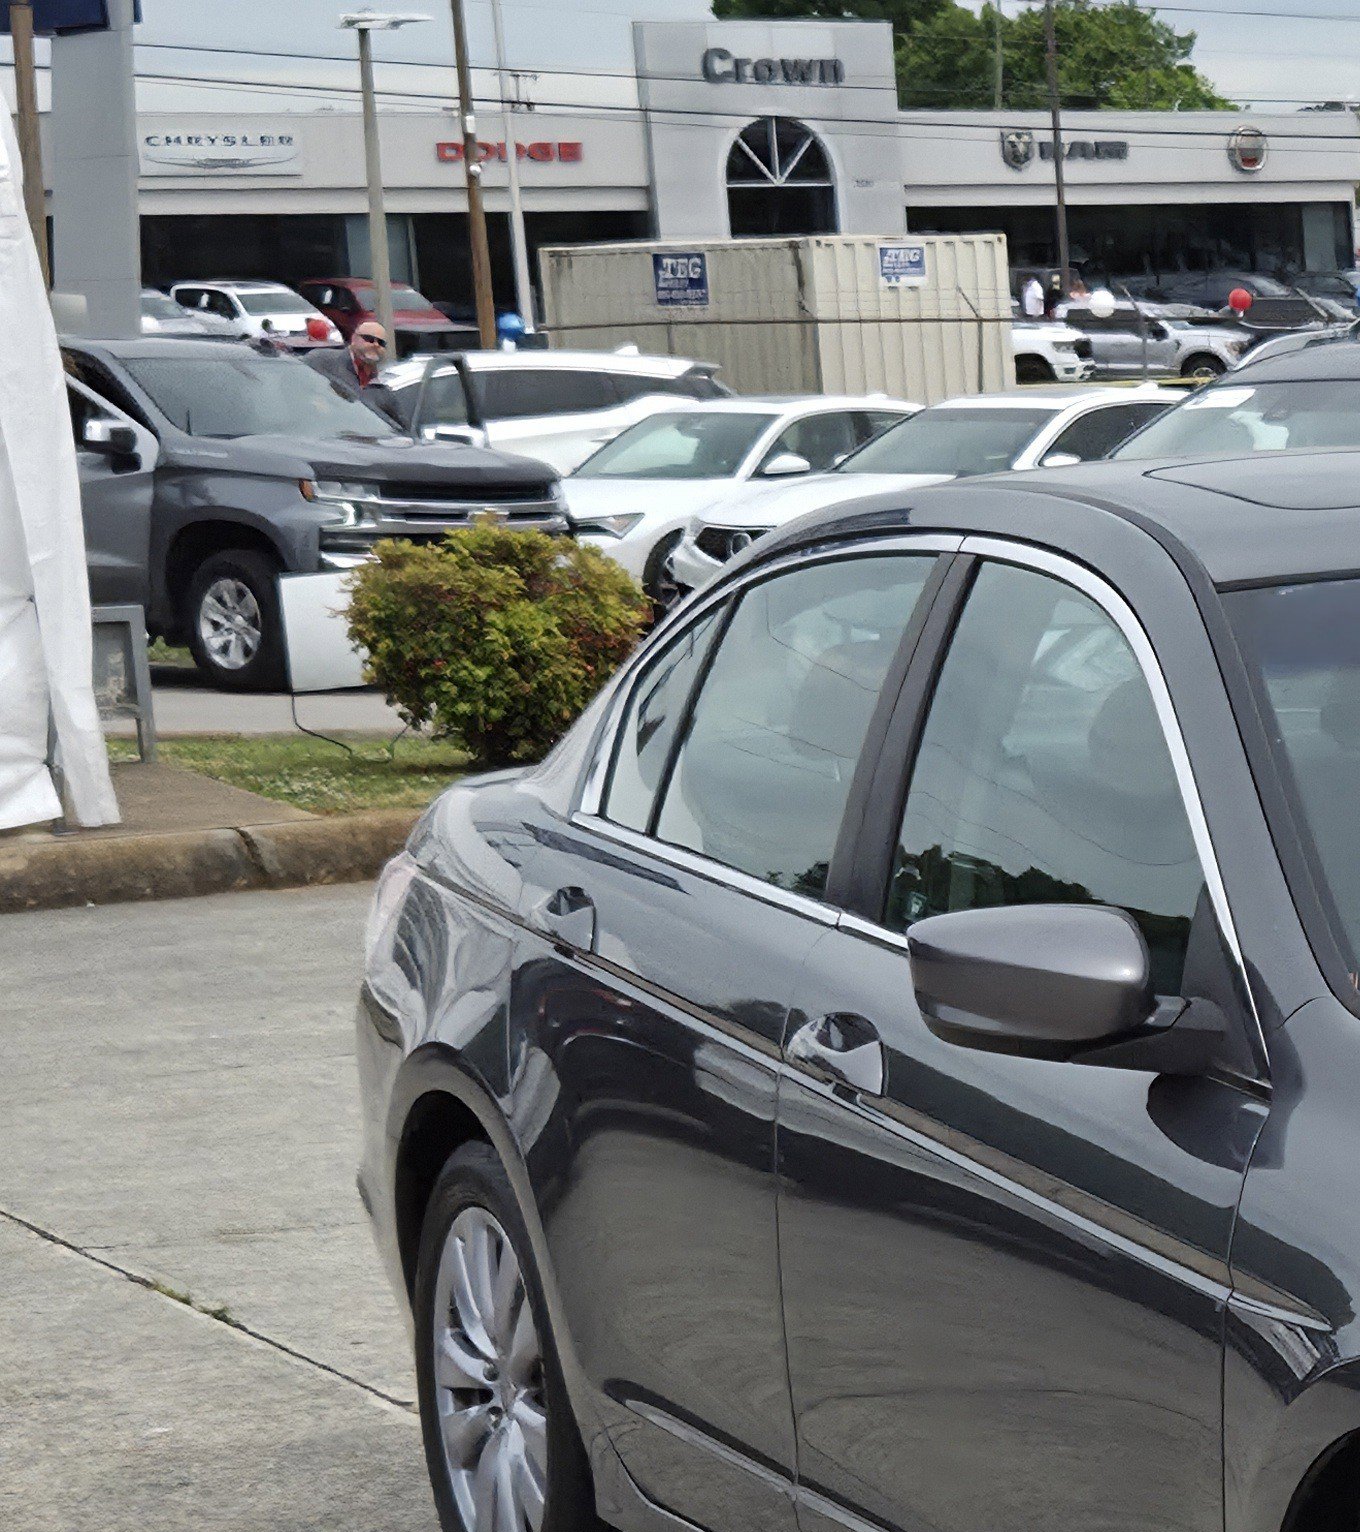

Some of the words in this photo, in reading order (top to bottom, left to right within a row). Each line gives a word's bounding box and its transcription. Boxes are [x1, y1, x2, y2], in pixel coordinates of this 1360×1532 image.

[702, 47, 845, 84] Crown
[144, 135, 294, 147] CHRYSLER
[436, 142, 583, 162] DODGE
